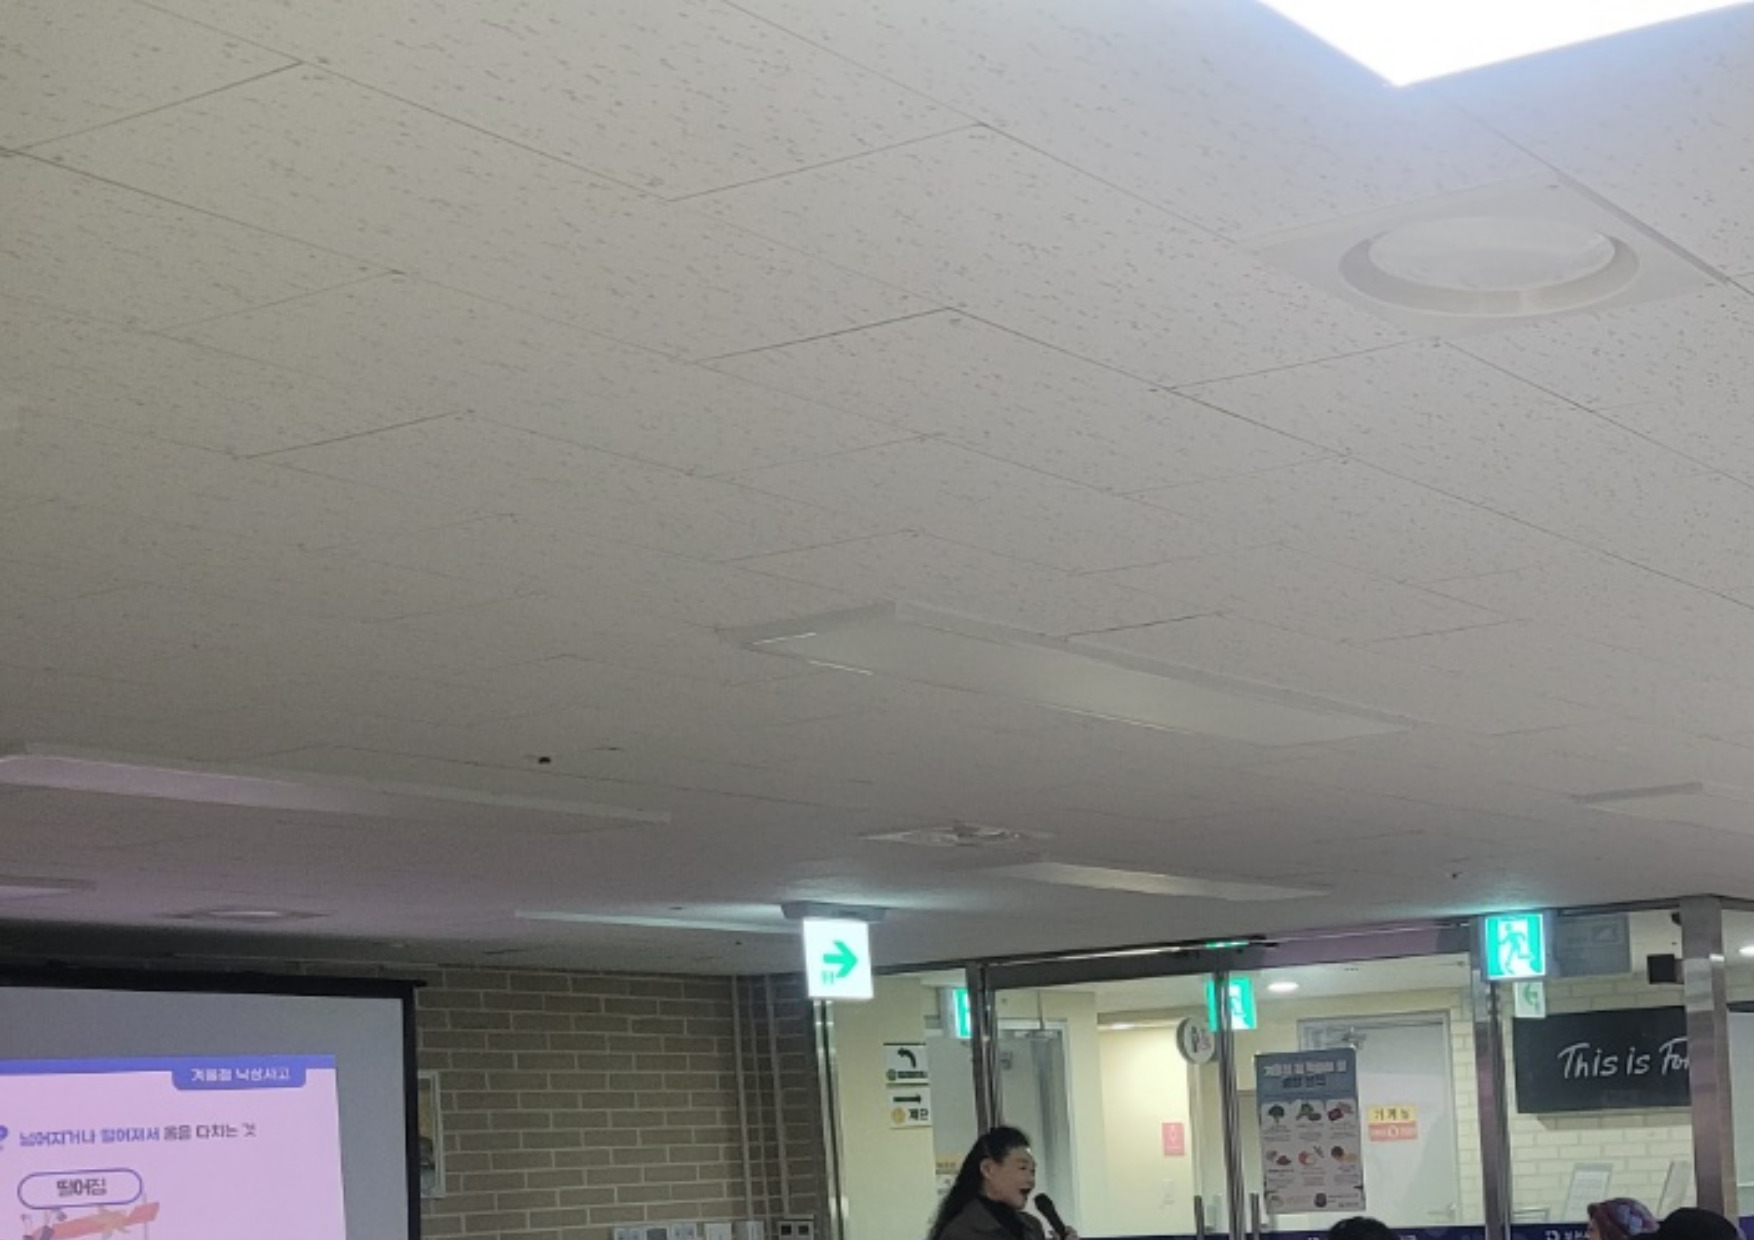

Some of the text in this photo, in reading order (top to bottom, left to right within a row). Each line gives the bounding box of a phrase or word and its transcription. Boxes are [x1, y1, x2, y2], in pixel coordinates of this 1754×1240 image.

[1557, 1041, 1618, 1079] This
[1625, 1045, 1650, 1074] is
[235, 1064, 293, 1082] 낙상사고
[19, 1129, 95, 1148] 넘어지거나
[196, 1123, 239, 1140] 다치는
[242, 1122, 257, 1138] 것
[56, 1177, 108, 1198] 떨어짐
